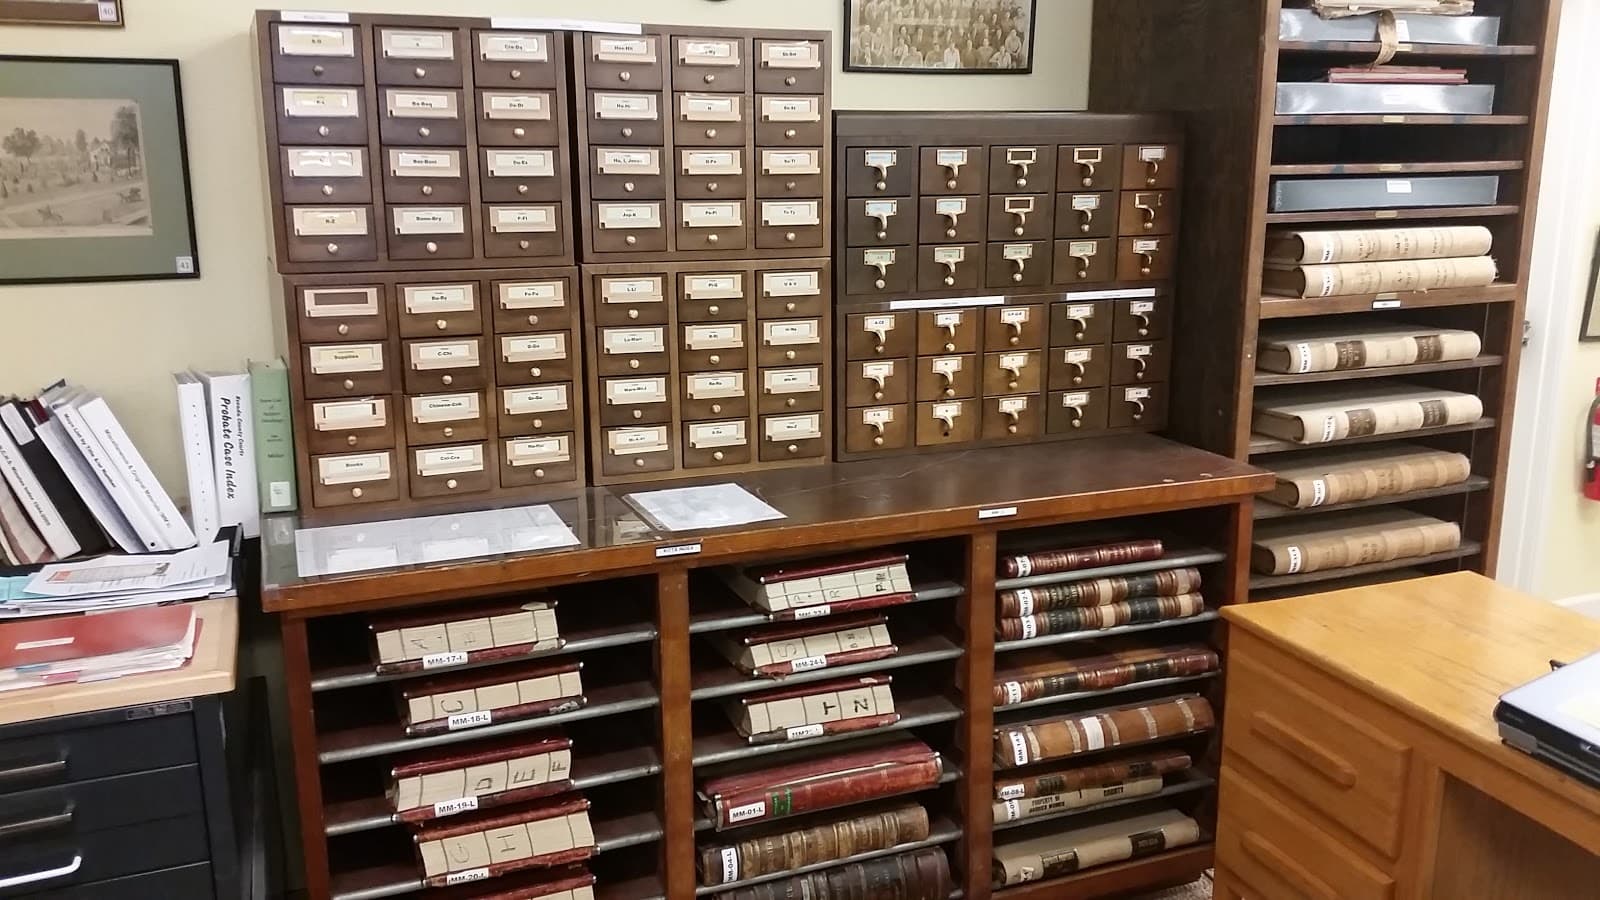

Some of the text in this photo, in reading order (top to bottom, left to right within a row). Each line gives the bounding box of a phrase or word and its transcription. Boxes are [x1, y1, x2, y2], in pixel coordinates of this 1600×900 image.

[220, 396, 237, 500] Probate Case Index
[427, 654, 465, 665] MM-17-L
[438, 800, 476, 814] MM-19-L
[732, 806, 764, 819] MM-01-L
